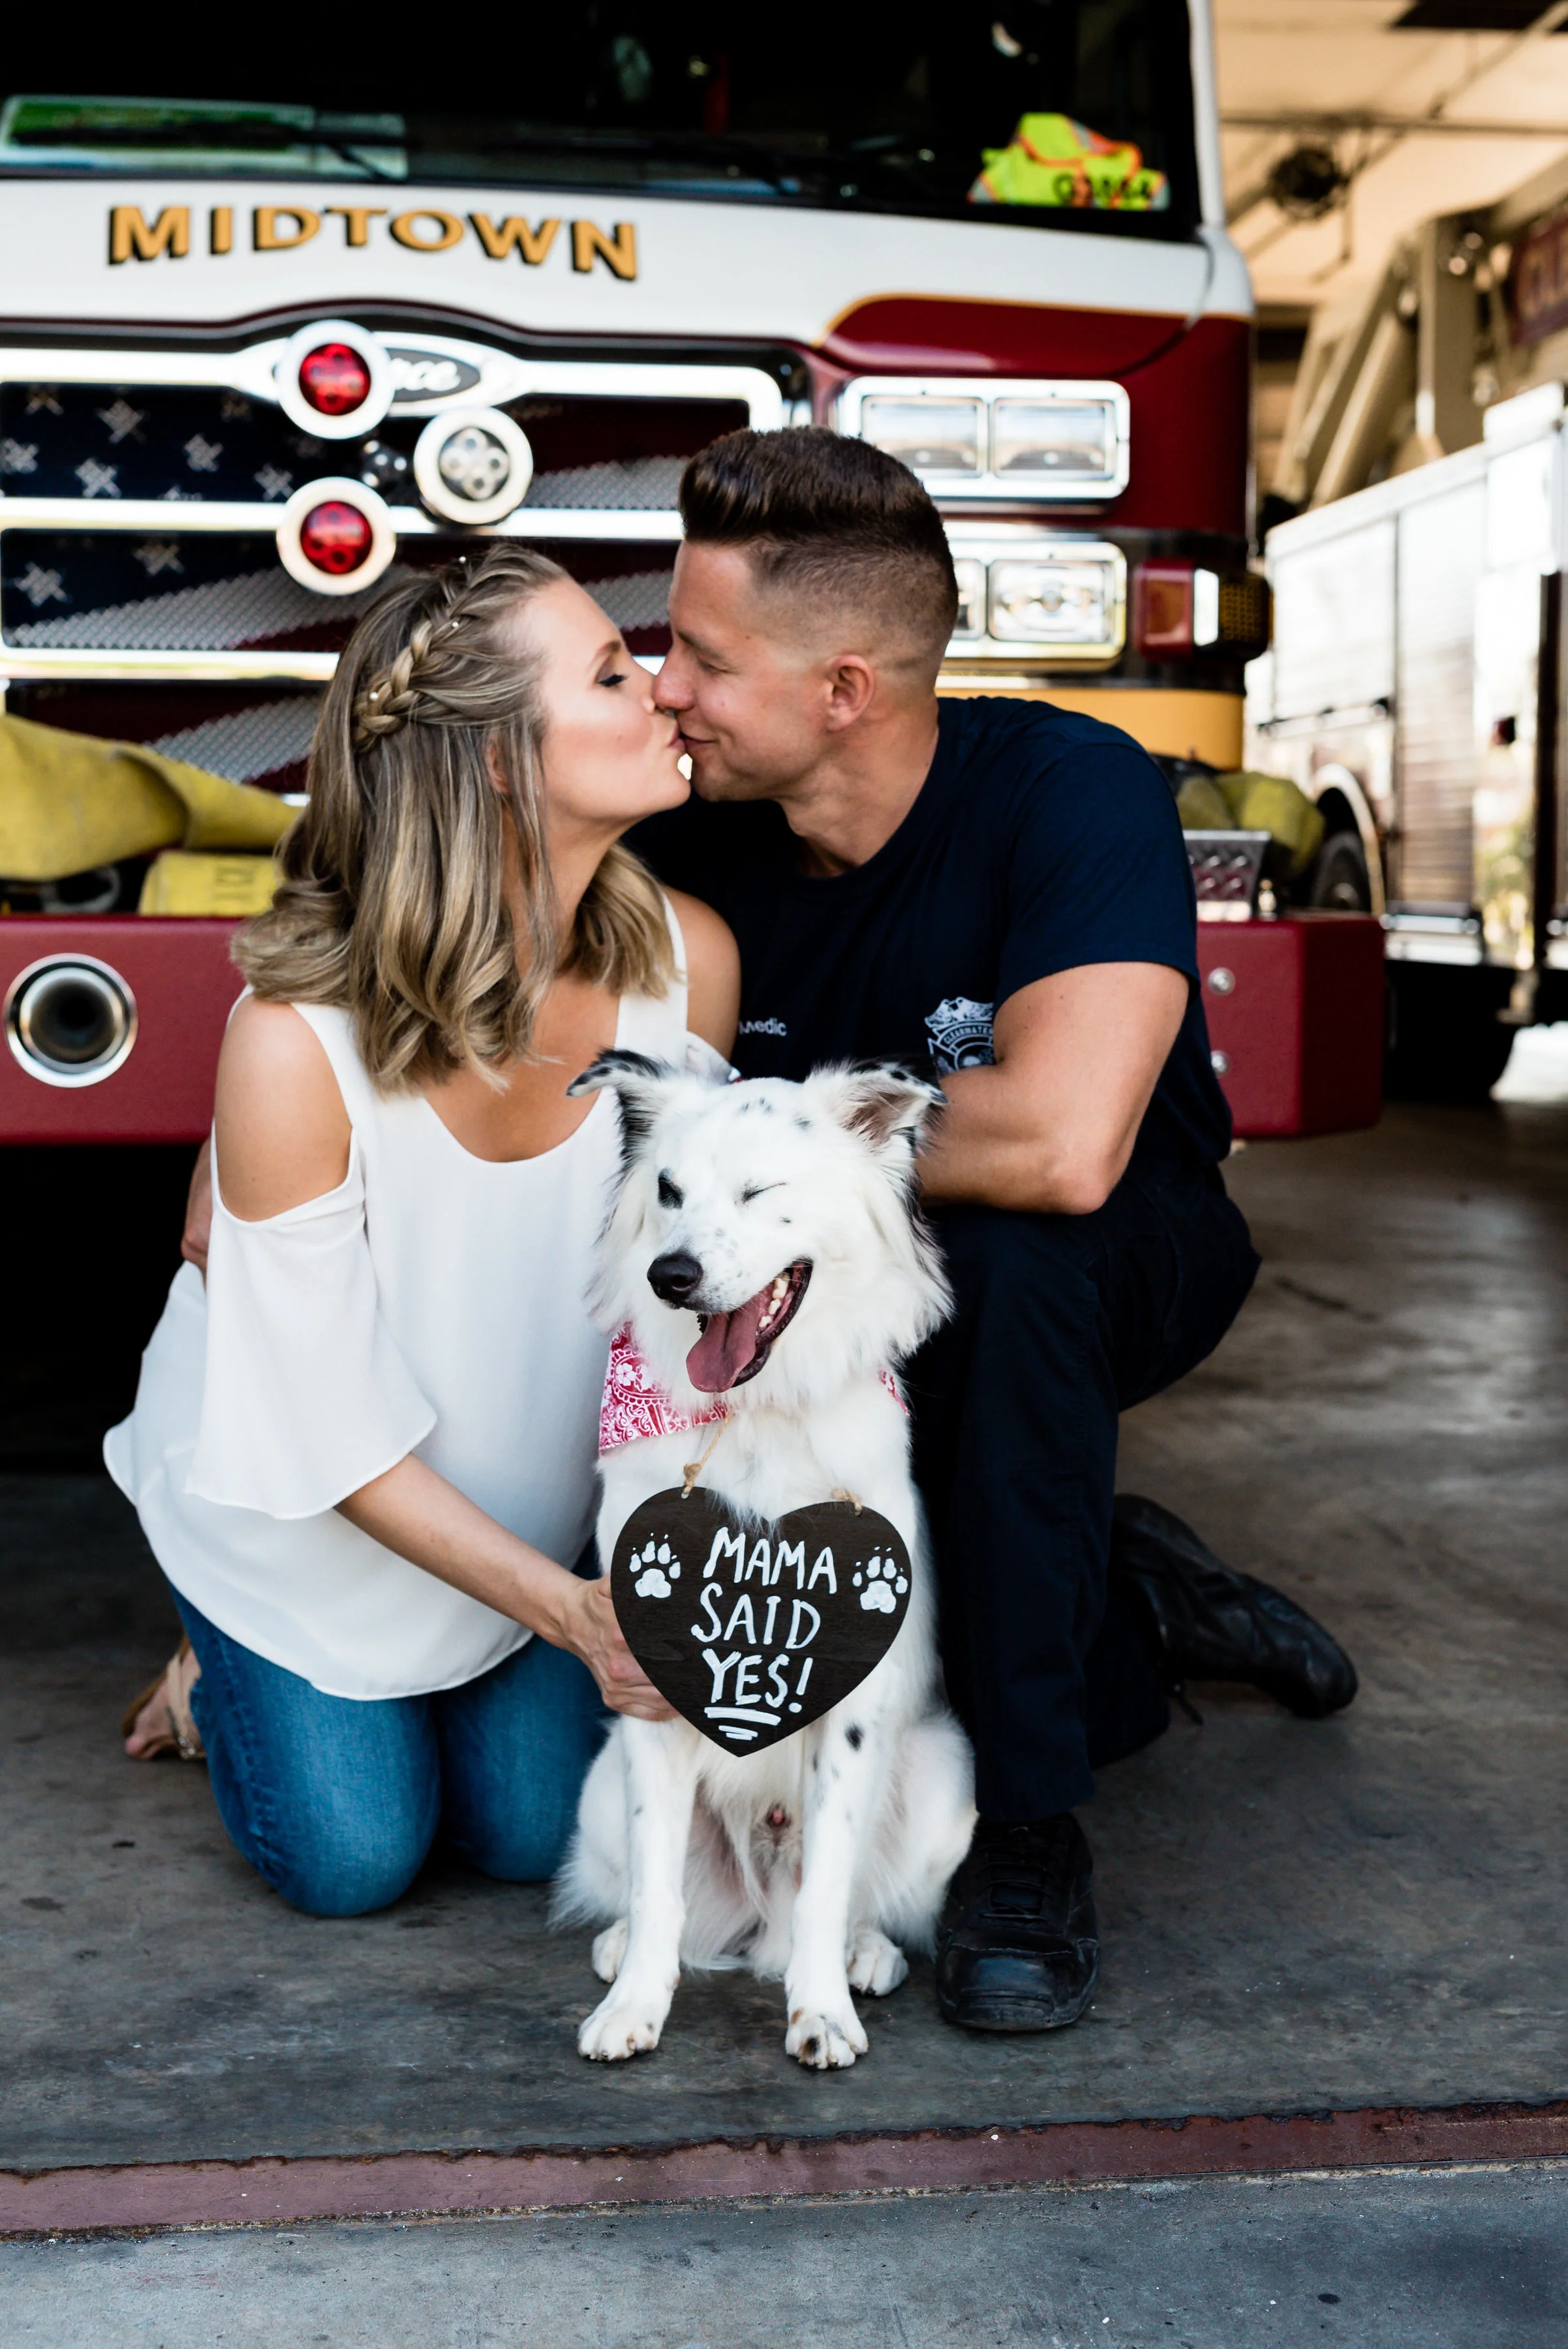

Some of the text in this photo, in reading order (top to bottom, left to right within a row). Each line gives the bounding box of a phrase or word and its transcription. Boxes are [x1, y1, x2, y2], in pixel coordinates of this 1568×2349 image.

[109, 206, 638, 281] MIDTOWN
[703, 1526, 837, 1594] MAMA
[691, 1582, 821, 1650] SAID
[701, 1648, 814, 1713] YES!
